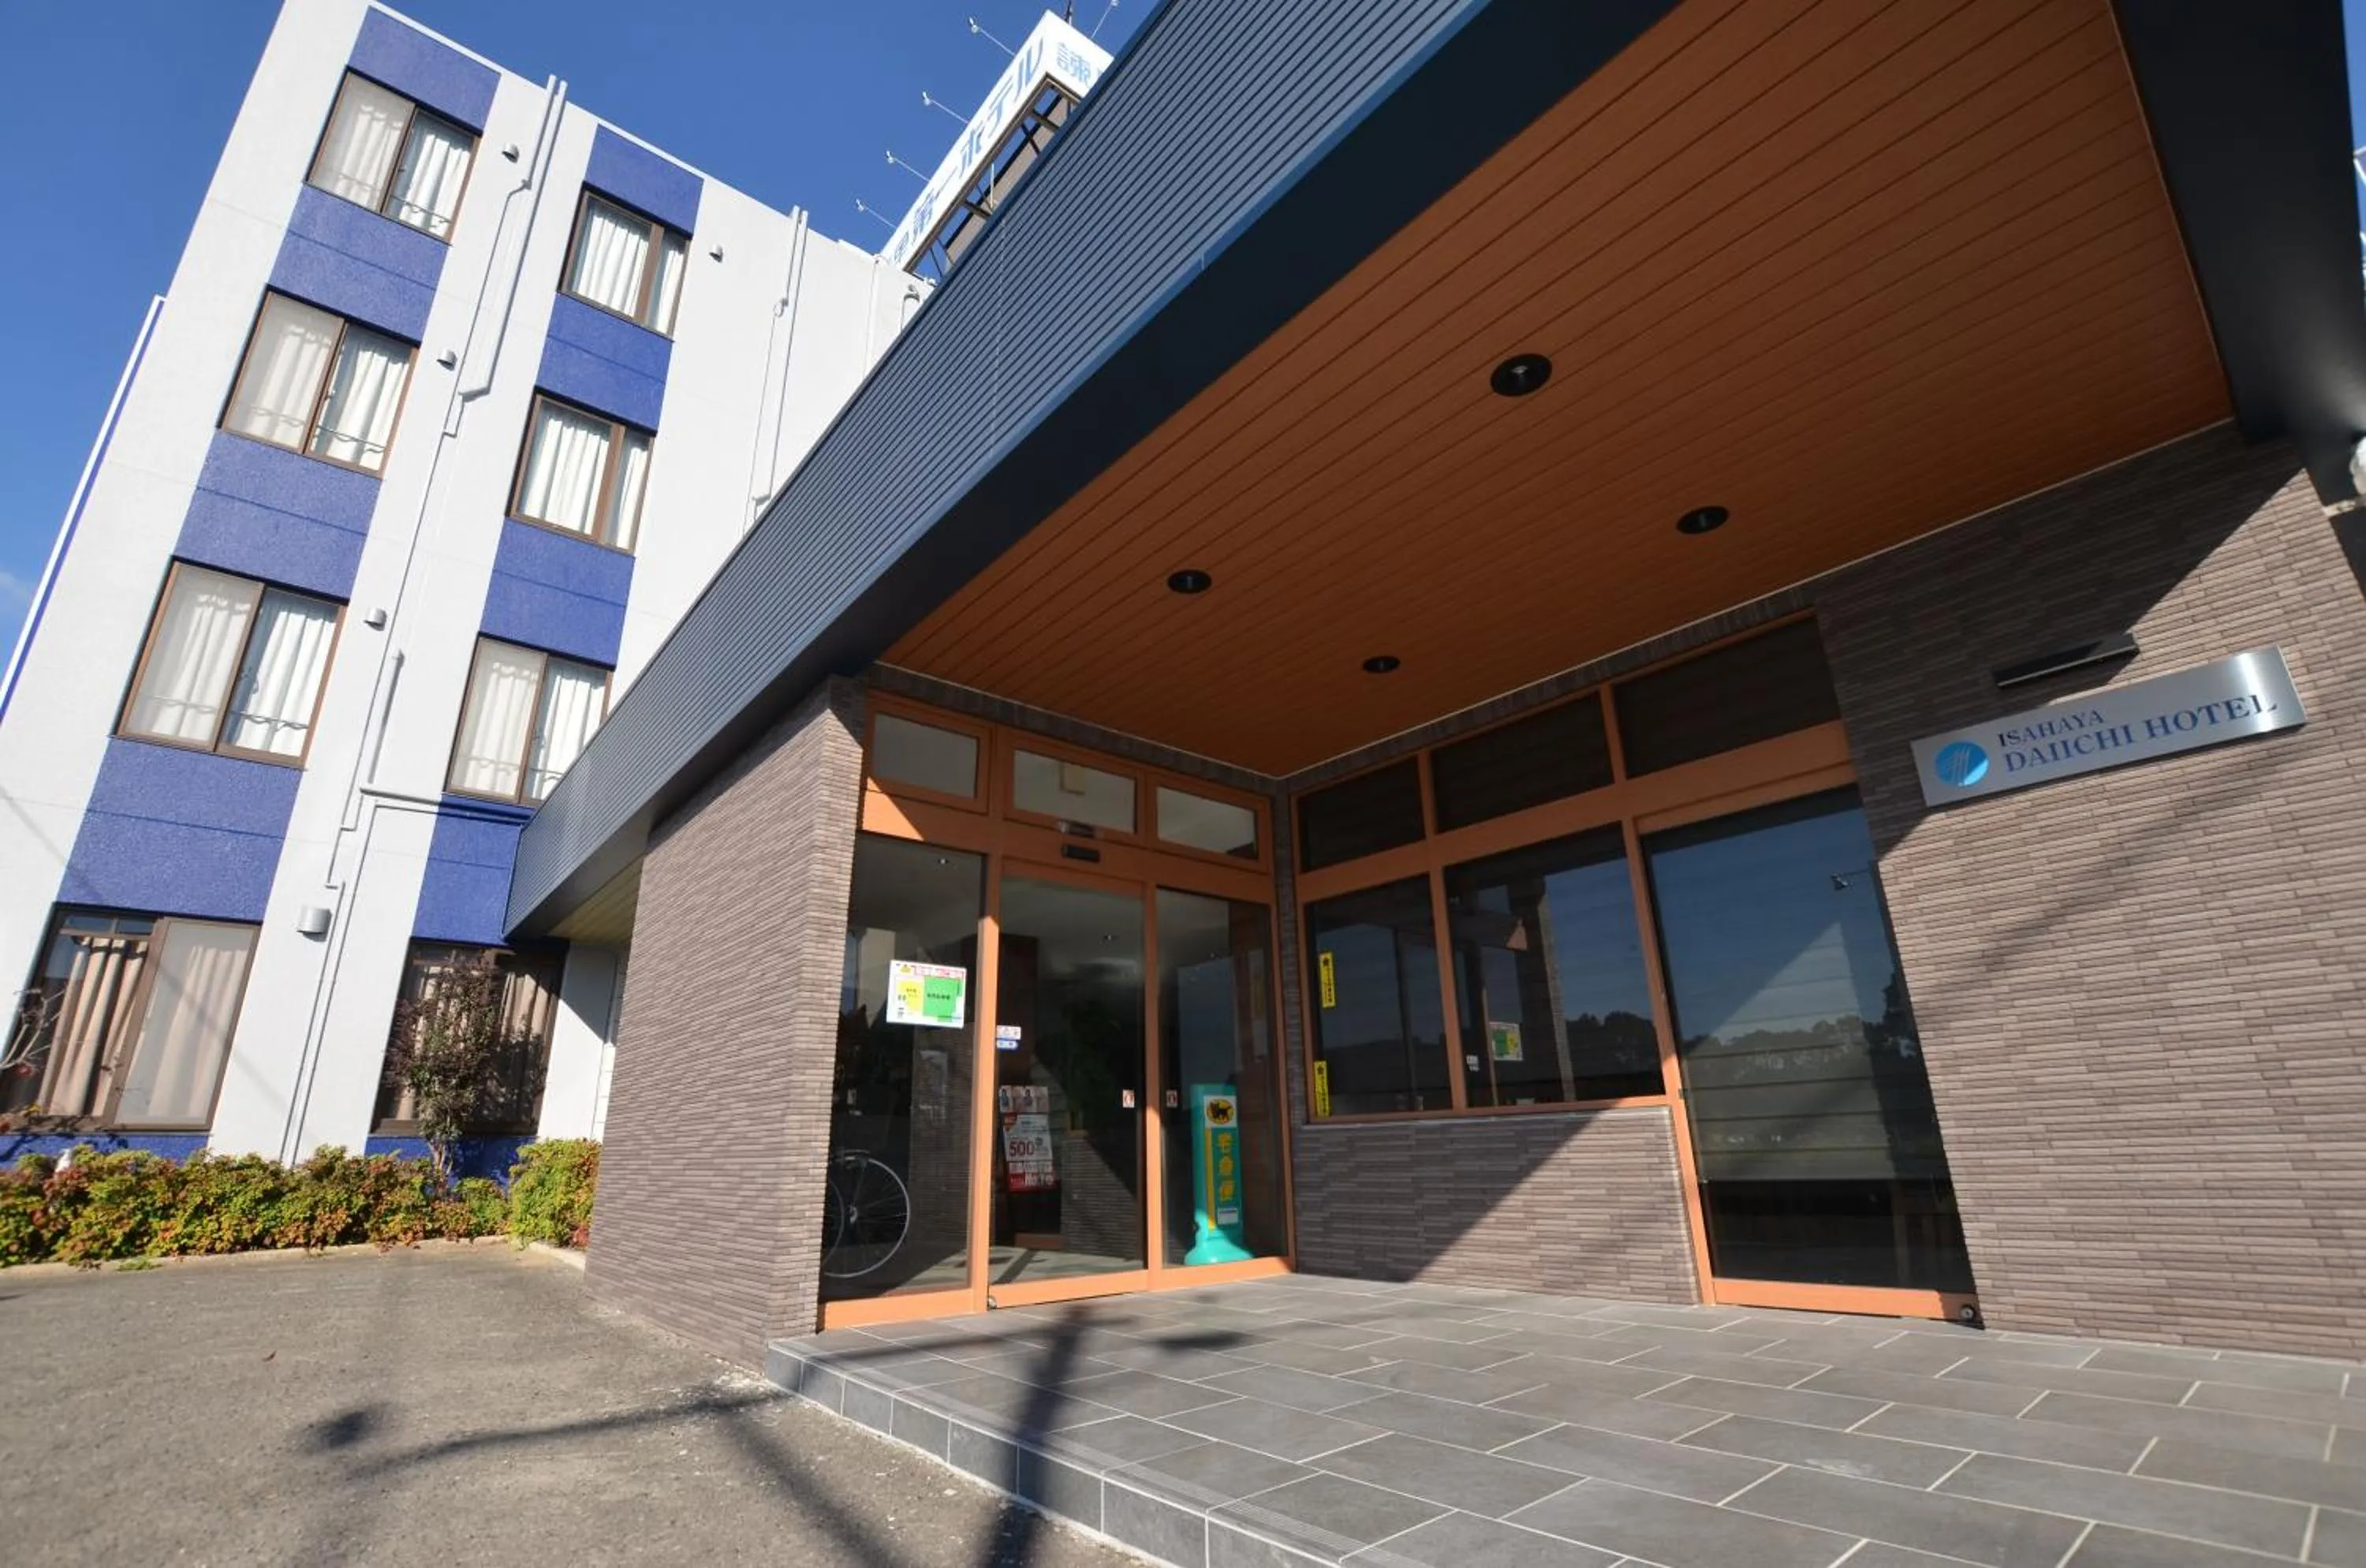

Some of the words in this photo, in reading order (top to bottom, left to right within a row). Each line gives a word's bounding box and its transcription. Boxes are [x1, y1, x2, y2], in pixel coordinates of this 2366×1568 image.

[1998, 709, 2104, 747] ISAHAYA
[2005, 725, 2136, 772] DAIICHI
[2143, 694, 2278, 739] HOTEL
[1009, 1139, 1035, 1157] 500
